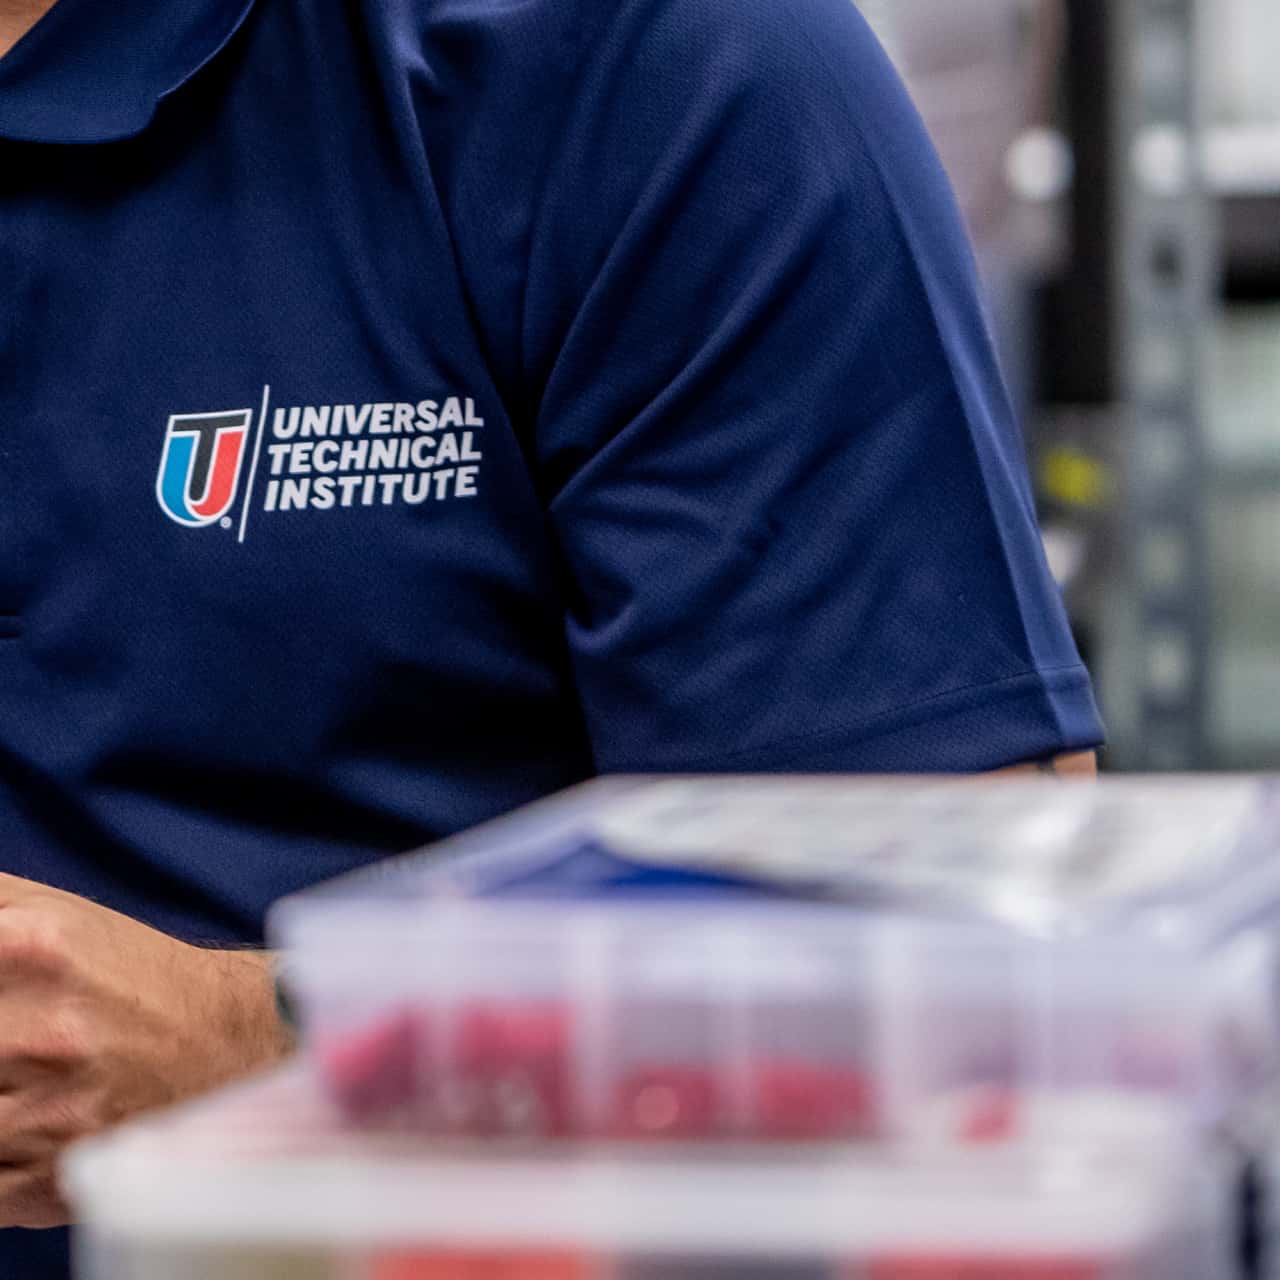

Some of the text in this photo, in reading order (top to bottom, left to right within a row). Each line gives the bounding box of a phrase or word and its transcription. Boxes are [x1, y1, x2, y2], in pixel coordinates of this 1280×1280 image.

[272, 396, 484, 439] UNIVERSAL
[267, 431, 482, 475] TECHNICAL
[264, 465, 480, 511] INSTITUTE
